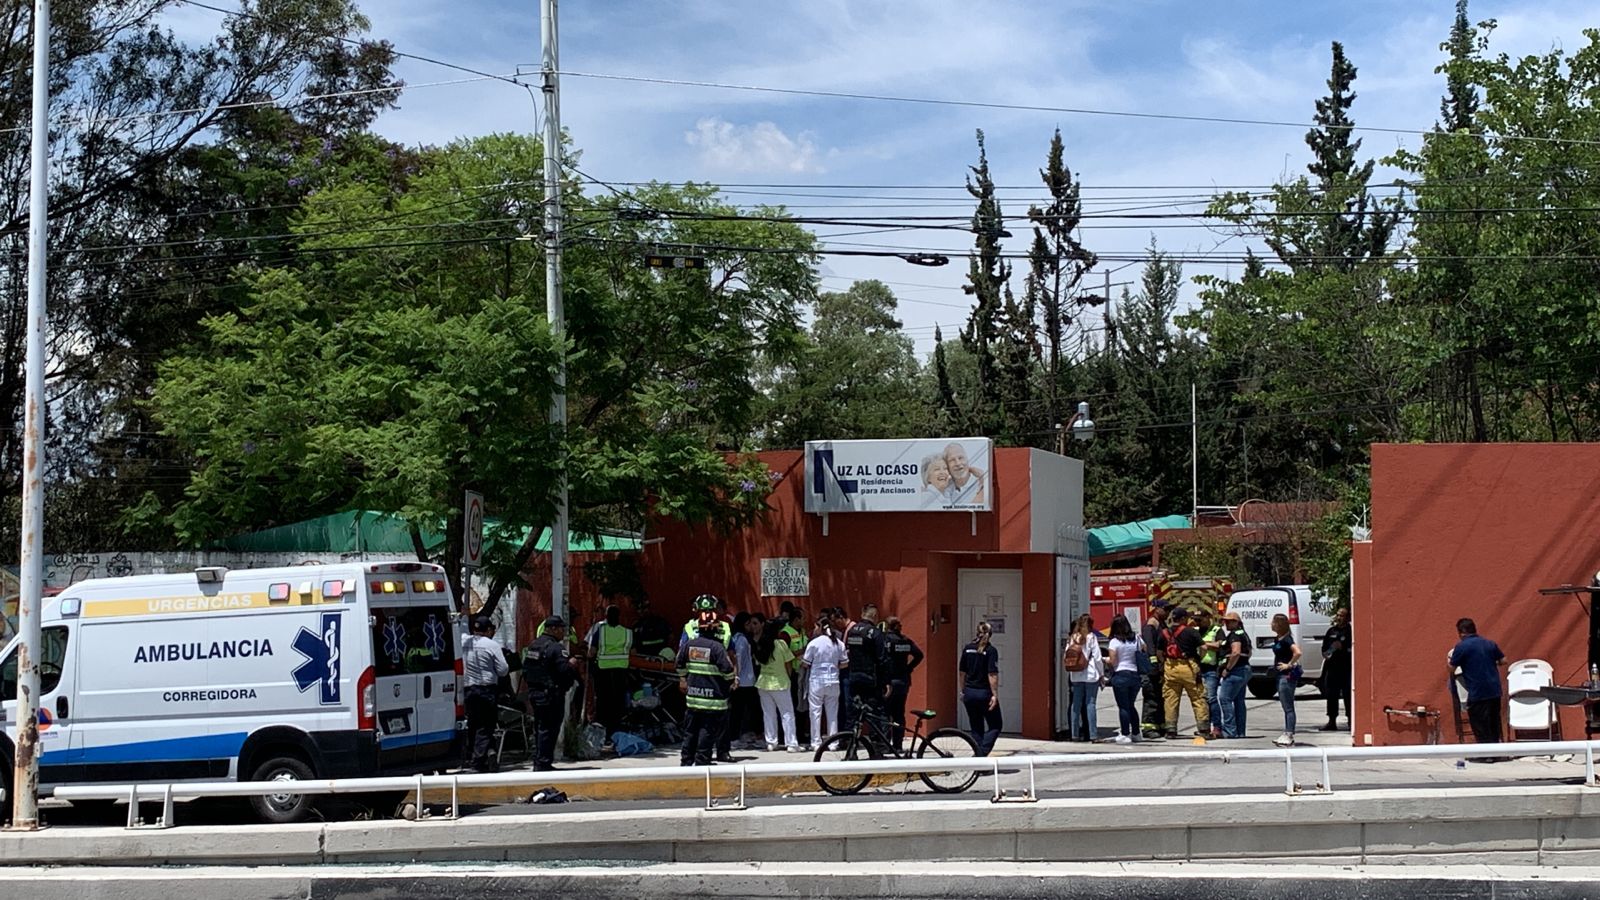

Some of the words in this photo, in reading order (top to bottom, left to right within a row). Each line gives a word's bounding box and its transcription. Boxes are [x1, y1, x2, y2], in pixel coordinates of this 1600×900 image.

[856, 464, 872, 476] AL
[875, 463, 918, 476] OCASO
[860, 478, 903, 486] Residencia
[880, 486, 915, 494] Ancianos
[780, 559, 792, 567] SE
[763, 567, 806, 577] SOLICITA
[762, 577, 806, 586] PERSONAL
[765, 585, 805, 594] LIMPIEZA
[148, 595, 252, 612] URGENCIAS
[1231, 599, 1258, 609] SERVICIO
[1257, 598, 1283, 608] MÉDICO
[1241, 610, 1268, 619] FORENSE
[134, 639, 273, 663] AMBULANCIA
[163, 689, 257, 702] CORREGIDORA
